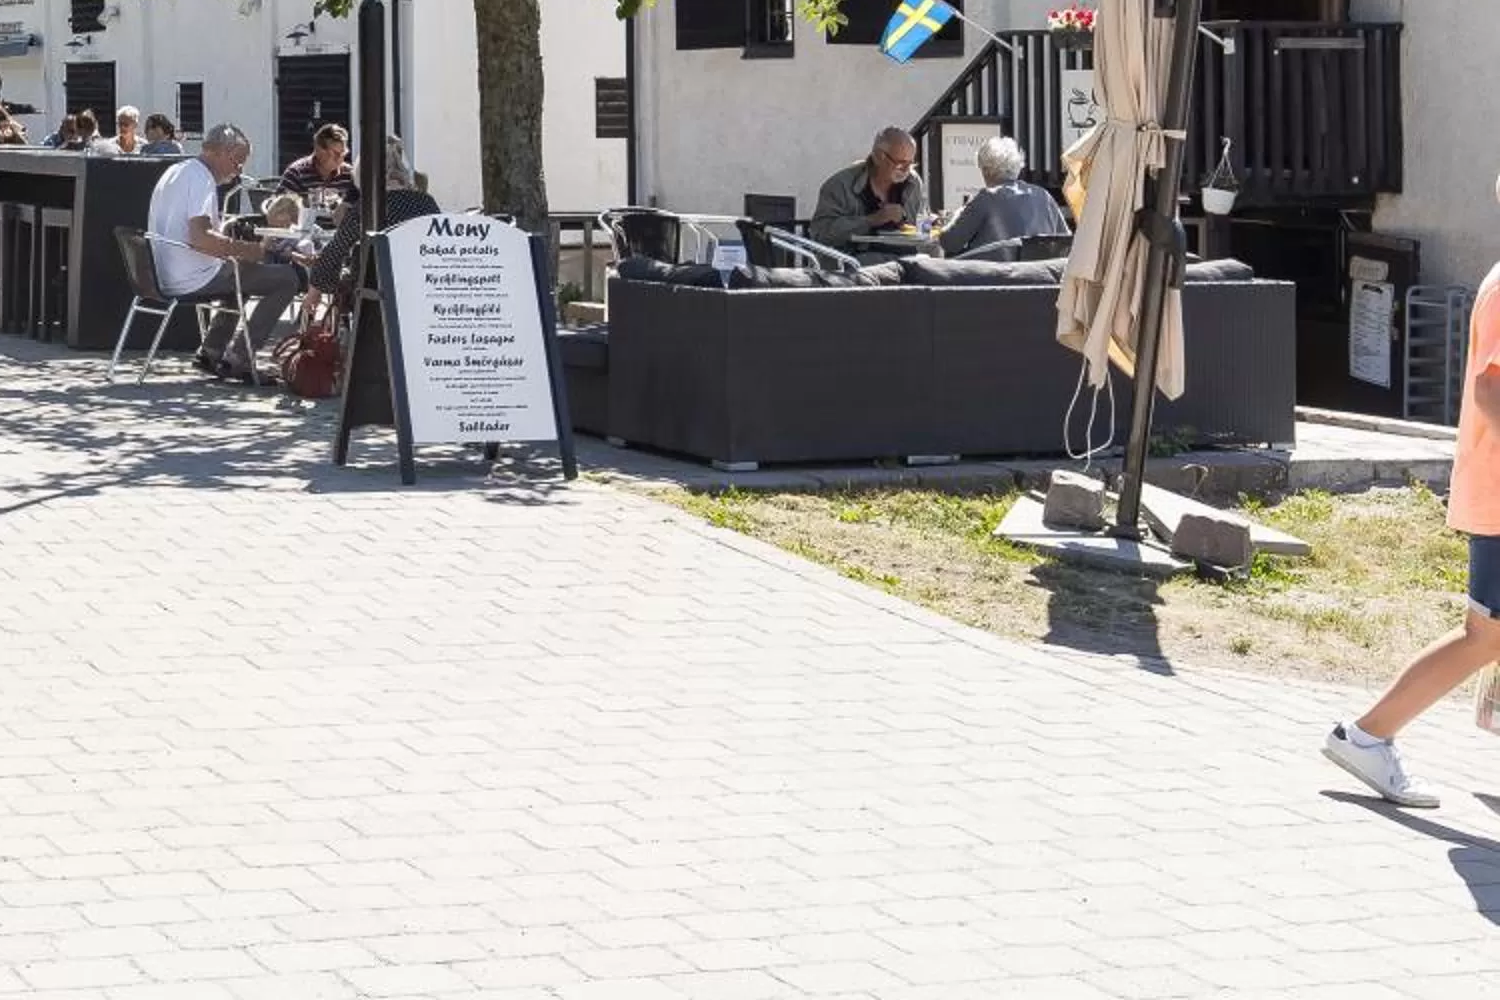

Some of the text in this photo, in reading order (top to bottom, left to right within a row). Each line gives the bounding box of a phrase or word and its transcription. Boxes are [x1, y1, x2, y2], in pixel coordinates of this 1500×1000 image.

[426, 217, 491, 241] Meny
[419, 243, 499, 257] Bakad potatis
[471, 332, 515, 347] lasagne
[423, 356, 461, 367] Varma
[459, 419, 510, 432] Sallader
